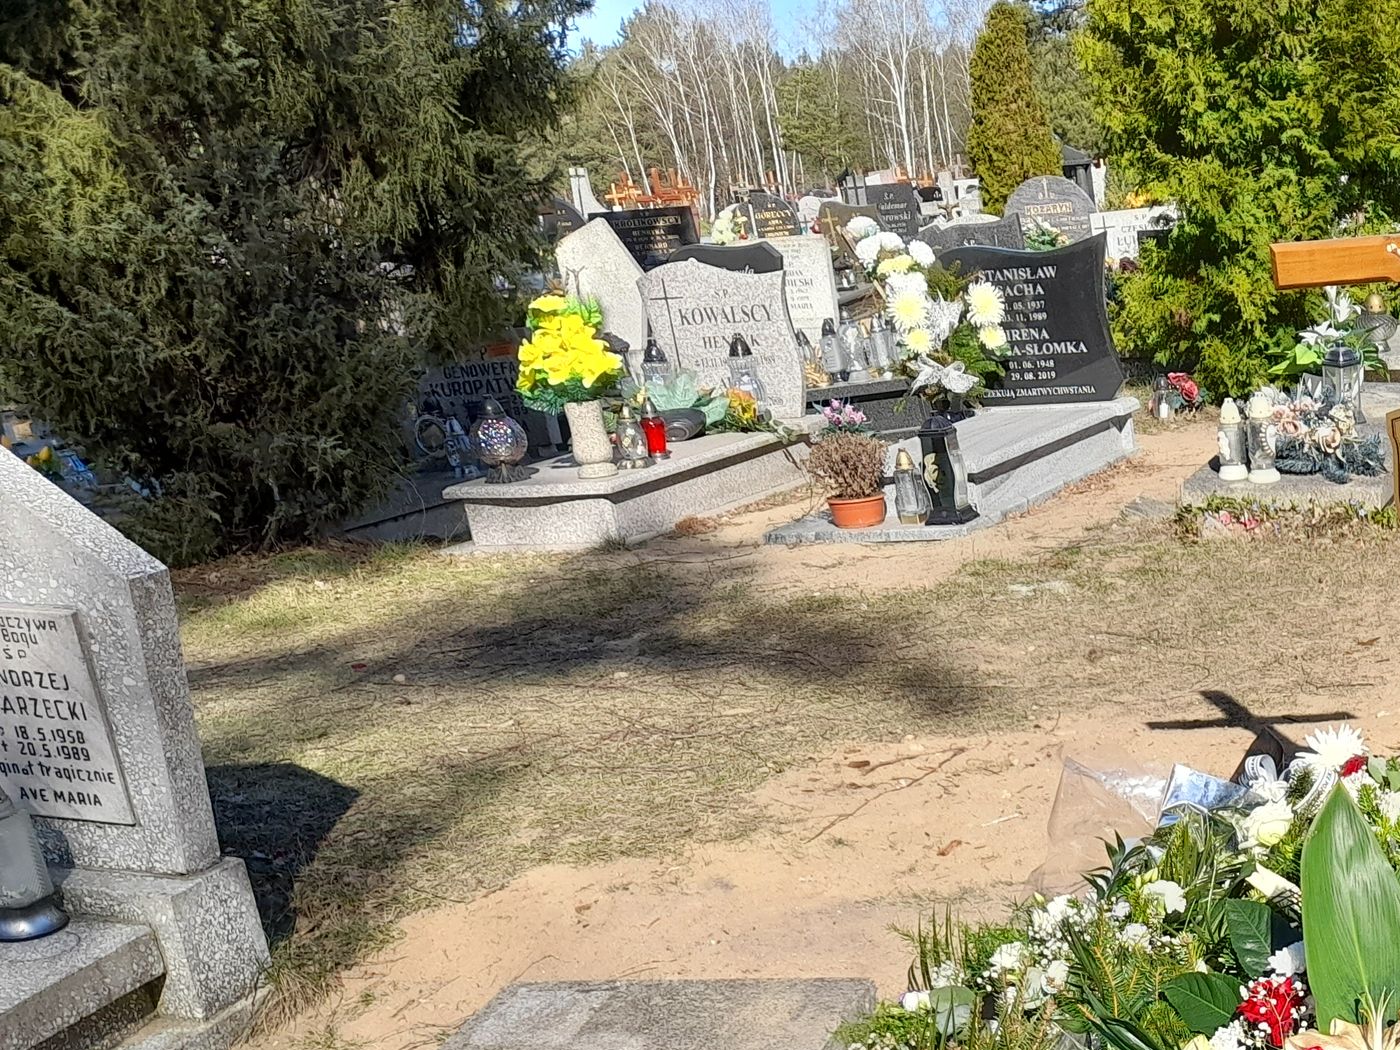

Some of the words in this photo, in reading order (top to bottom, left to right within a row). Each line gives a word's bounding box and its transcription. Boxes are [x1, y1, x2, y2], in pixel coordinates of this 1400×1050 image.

[978, 265, 1057, 283] STANISŁAW
[678, 303, 773, 327] KOWALSCY
[443, 361, 516, 380] GENOWEFA
[1037, 371, 1056, 380] 2019
[15, 726, 86, 745] 18.5.1958
[20, 741, 92, 762] 20.5.1989
[38, 761, 116, 785] tragicznie
[20, 787, 49, 802] AVE
[53, 792, 103, 807] MARIA
